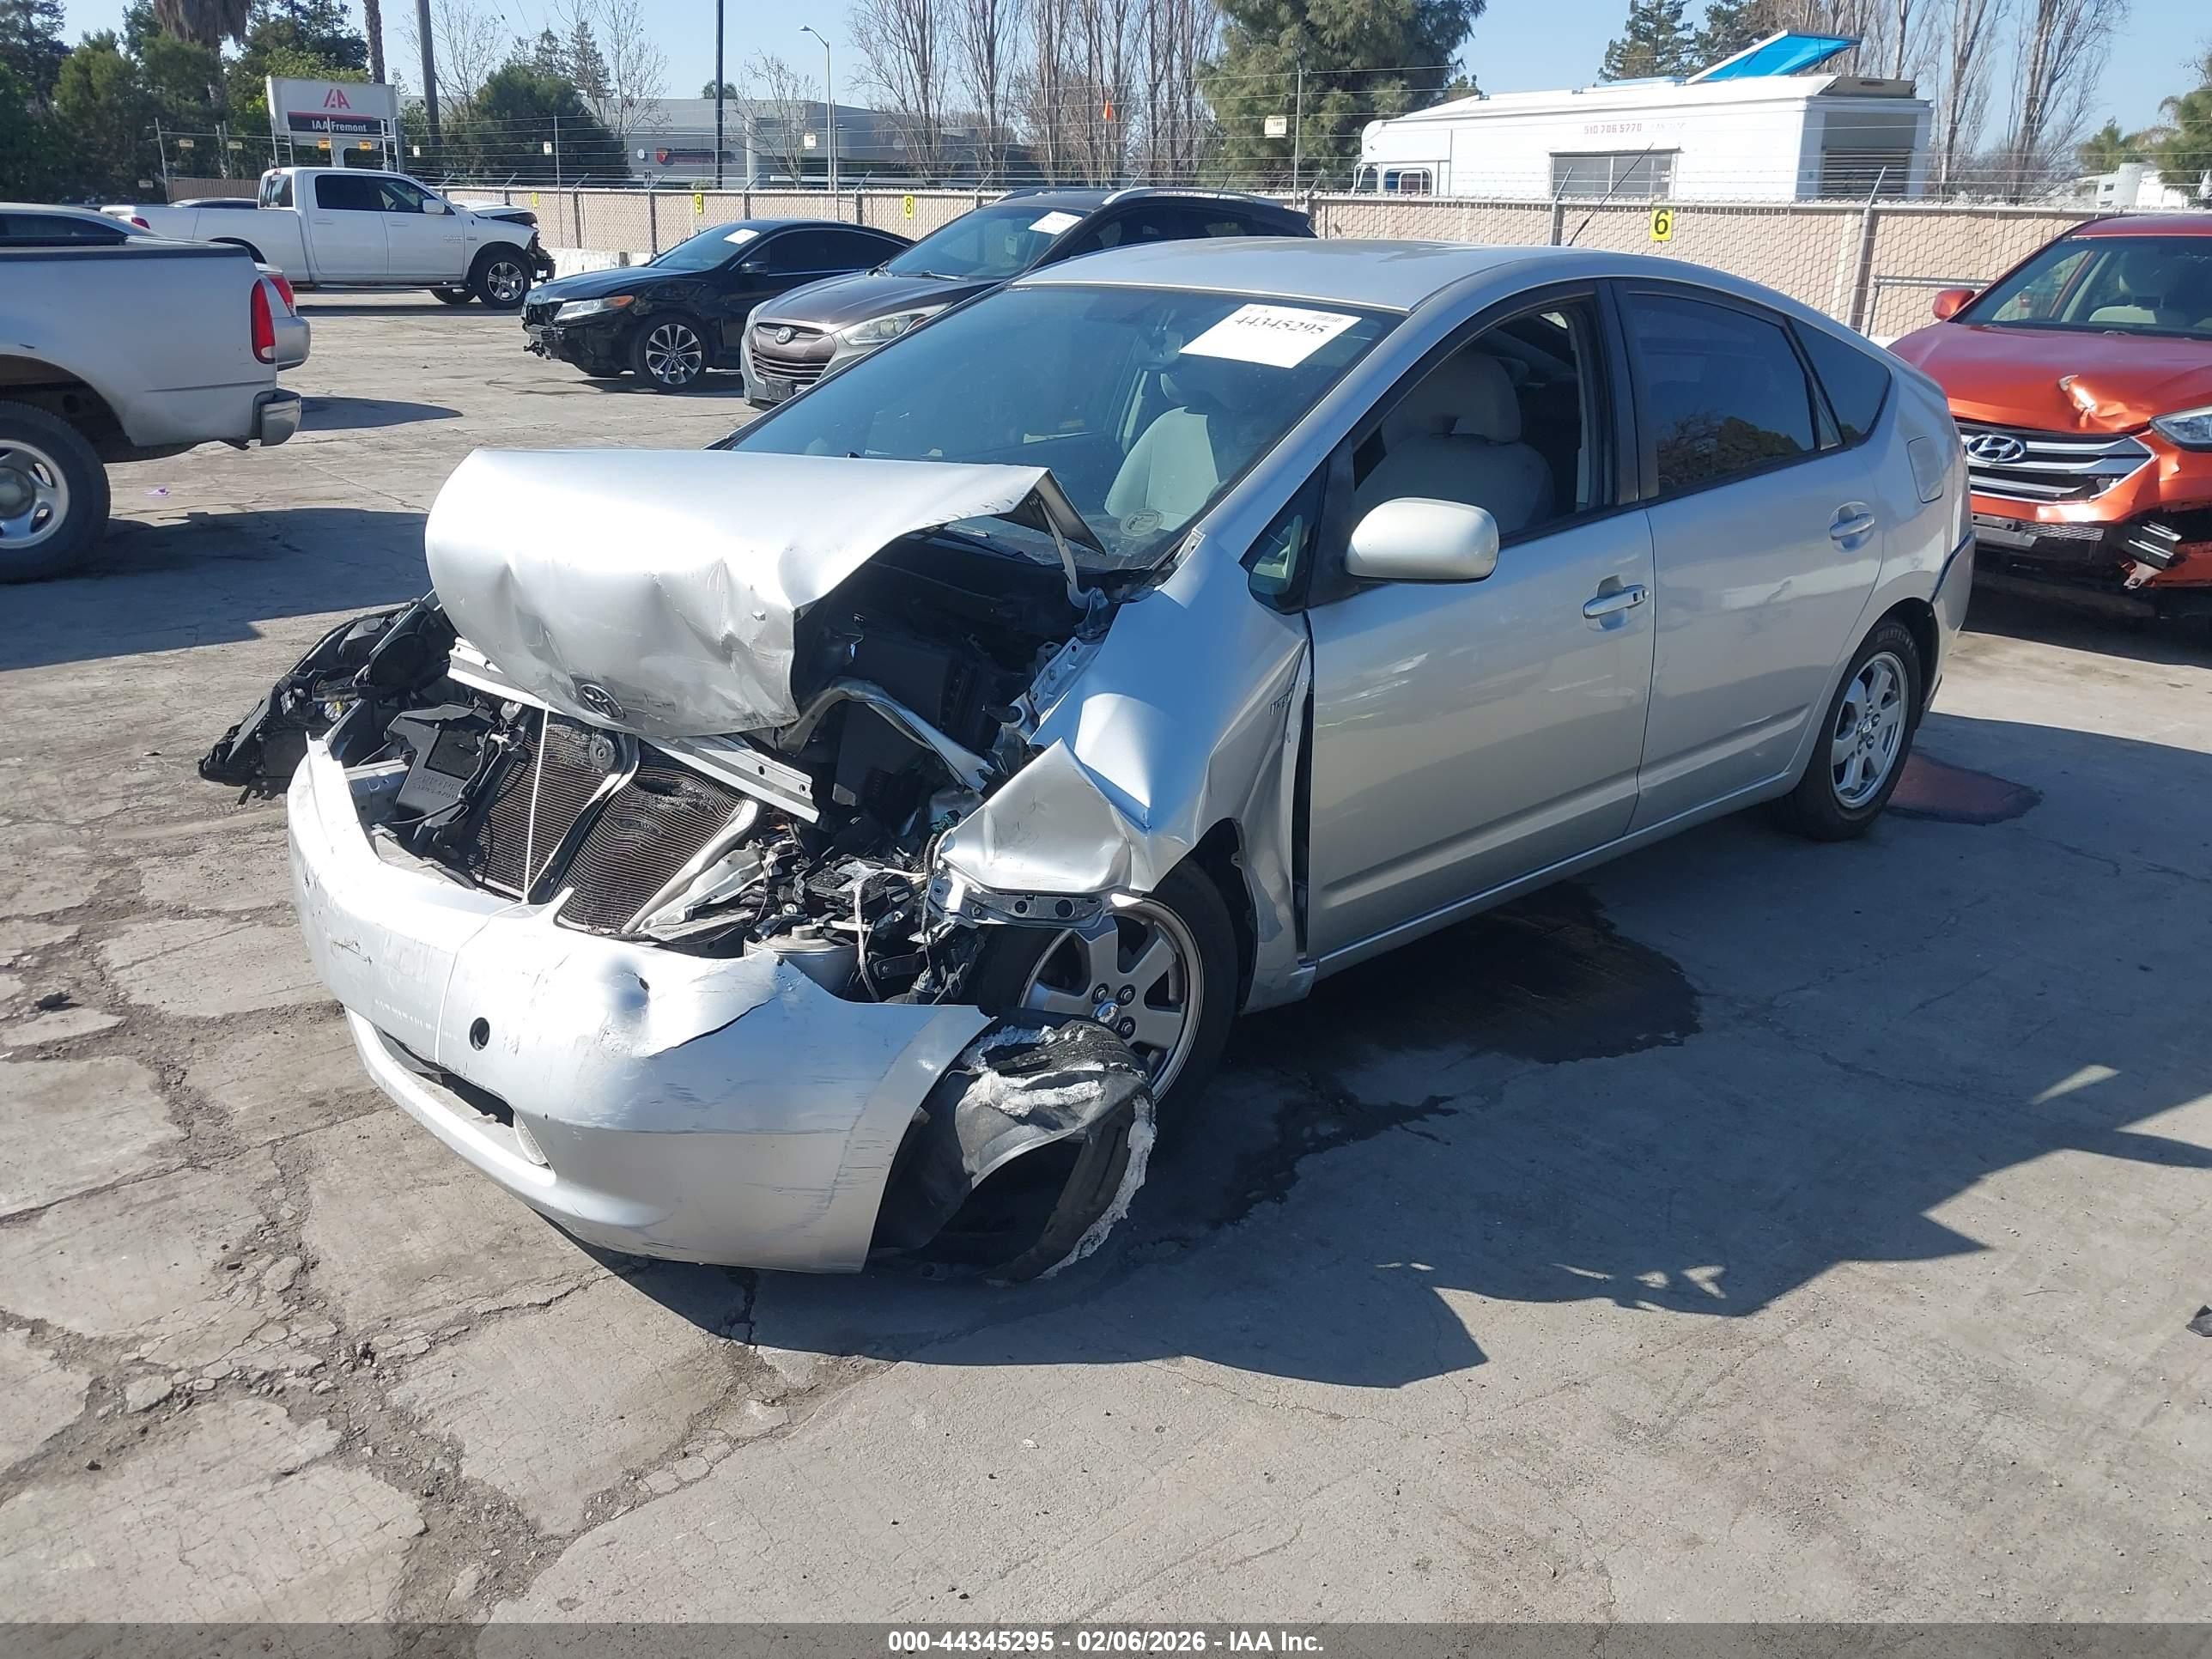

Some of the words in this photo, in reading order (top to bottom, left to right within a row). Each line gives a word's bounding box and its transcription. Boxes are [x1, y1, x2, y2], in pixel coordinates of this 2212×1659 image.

[311, 119, 329, 130] IAA
[331, 122, 368, 132] Fremont
[1583, 125, 1598, 134] 510
[1620, 123, 1642, 133] 5770
[696, 196, 701, 210] 9
[906, 198, 912, 214] 8
[1655, 209, 1668, 234] 6
[1235, 316, 1330, 335] 44345295
